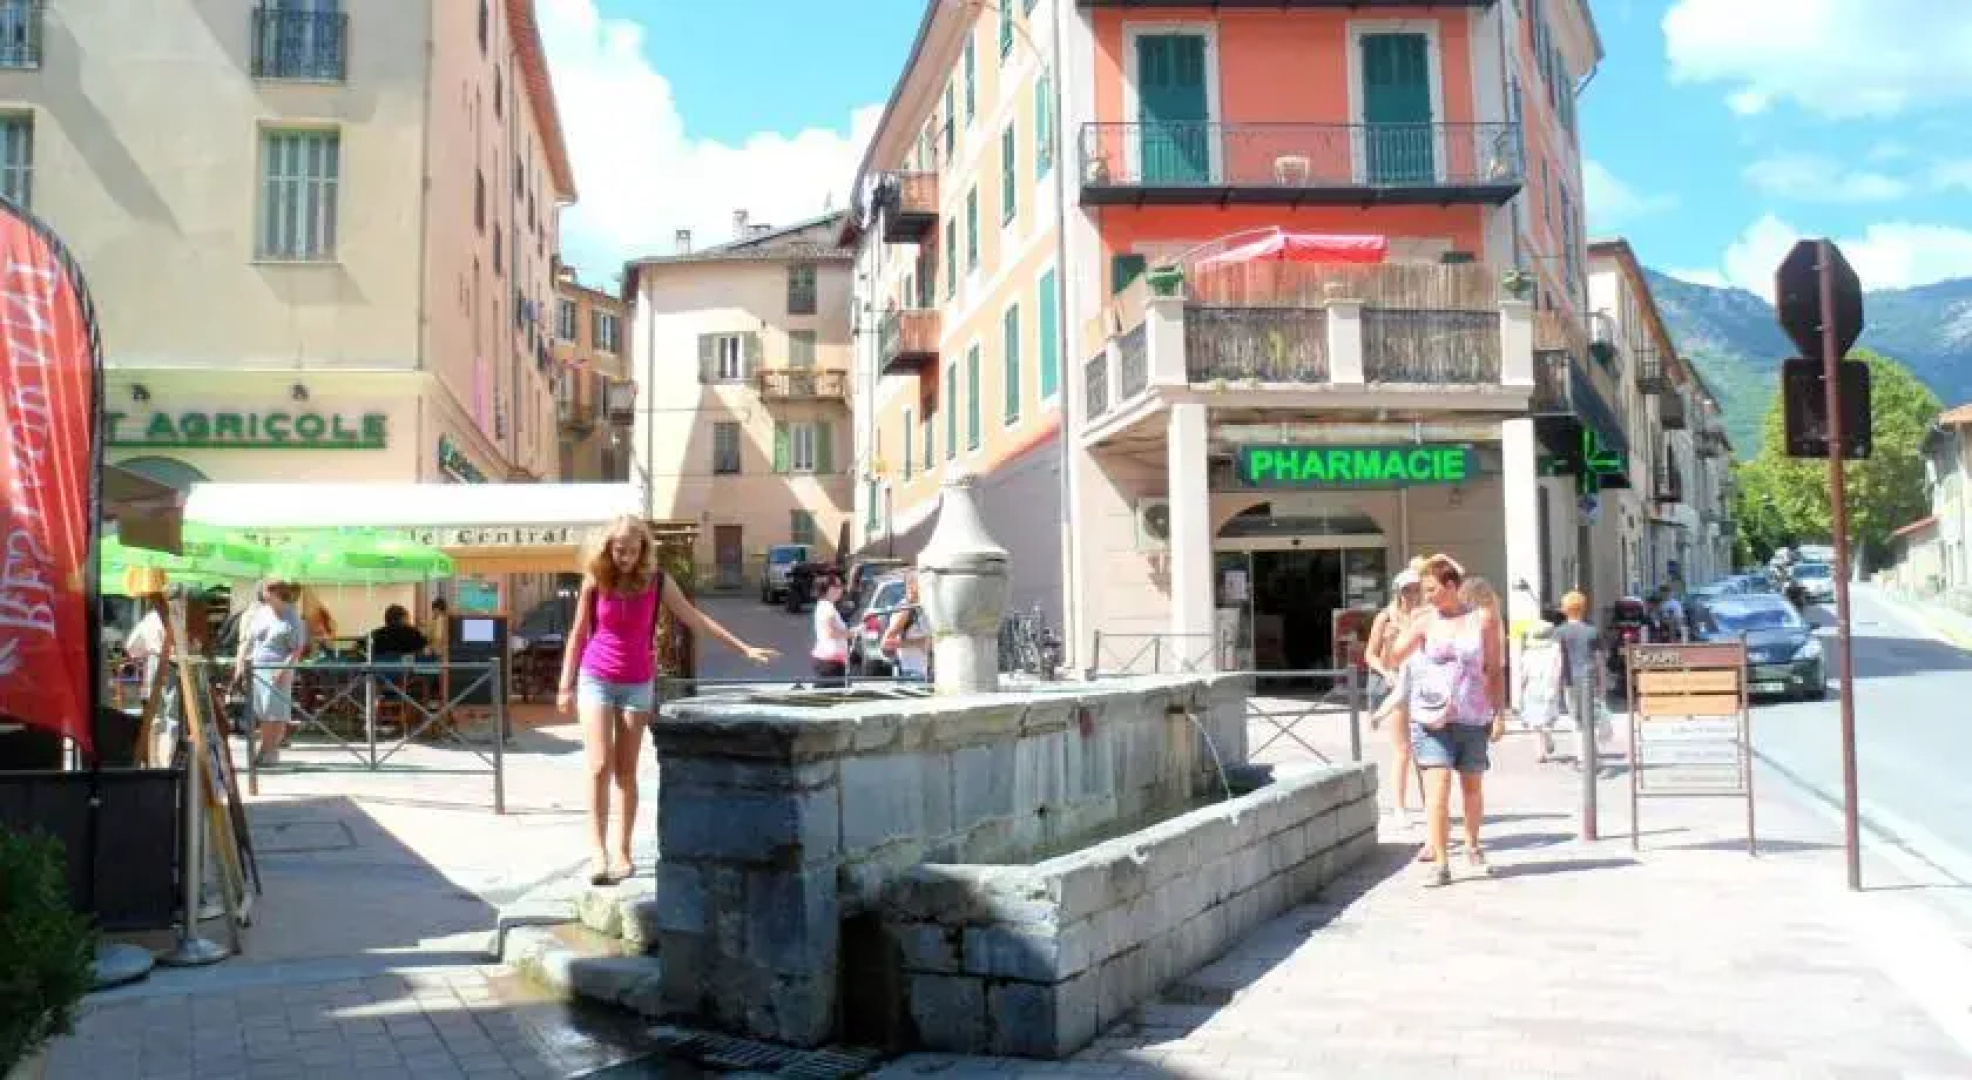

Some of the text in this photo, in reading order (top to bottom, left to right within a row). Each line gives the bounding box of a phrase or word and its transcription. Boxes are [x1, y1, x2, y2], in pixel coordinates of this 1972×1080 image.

[145, 412, 386, 439] AGRICOLE
[1250, 449, 1466, 481] PHARMACIE
[457, 527, 567, 544] Central
